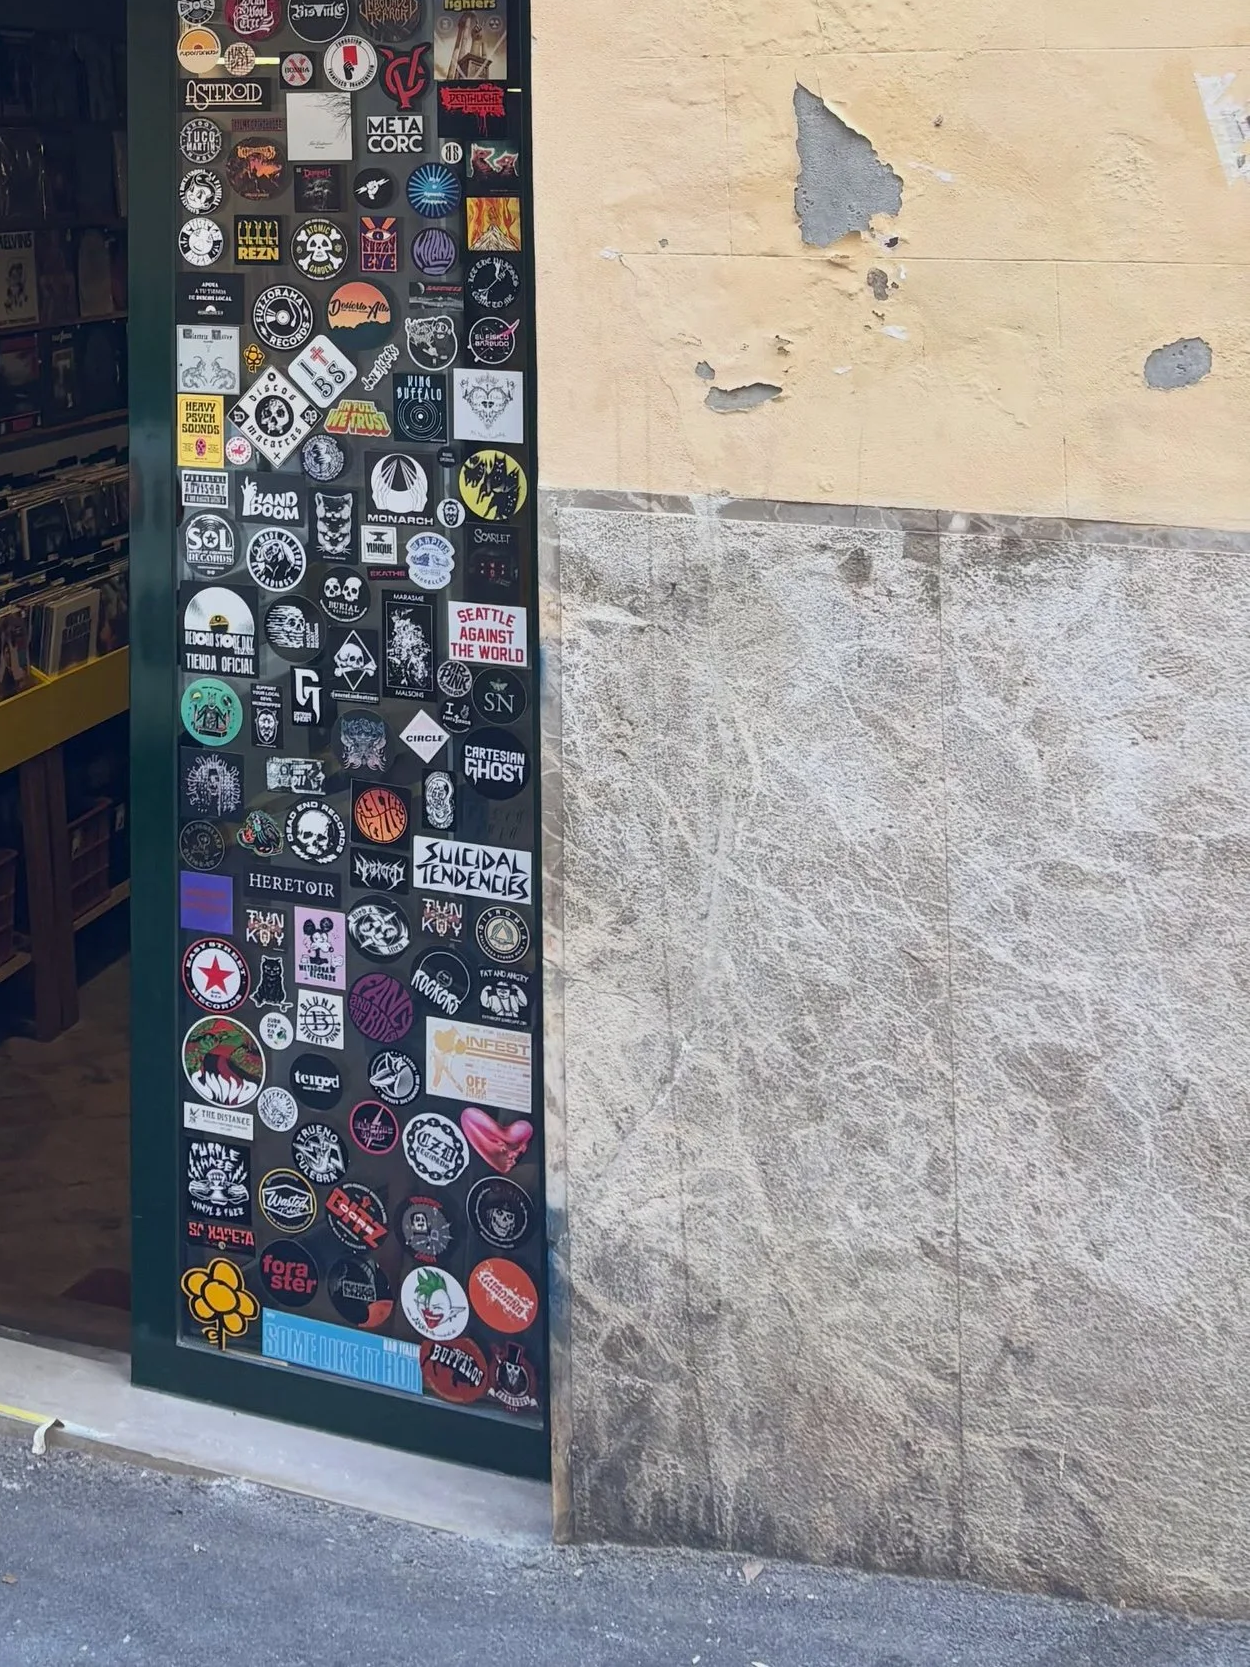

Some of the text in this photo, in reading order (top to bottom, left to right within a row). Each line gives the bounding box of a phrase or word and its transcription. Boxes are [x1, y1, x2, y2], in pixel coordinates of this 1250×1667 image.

[185, 80, 262, 111] ASTEROID
[367, 117, 423, 134] META
[186, 131, 216, 142] TUCO
[367, 135, 423, 153] CORC
[306, 223, 331, 235] ATOMIC
[238, 248, 279, 260] REZN
[363, 238, 396, 253] FUZZY
[308, 263, 334, 275] GARDEN
[363, 253, 396, 271] EYE
[255, 288, 304, 324] FUZZORAMA
[269, 321, 310, 347] RECORDS
[407, 375, 431, 386] KING
[396, 387, 442, 402] BUFFALO
[185, 401, 216, 413] HEAVY
[185, 413, 216, 423] PSYCH
[350, 411, 390, 432] TRUST
[181, 424, 220, 435] SOUNDS
[253, 491, 299, 507] HAND
[251, 503, 300, 520] DOOM
[367, 513, 434, 526] MONARCH
[187, 526, 233, 551] SOL
[457, 606, 517, 628] SEATTLE
[459, 626, 514, 645] AGAINST
[451, 642, 524, 663] THE WORLD
[186, 653, 255, 675] TIENDA OFICIAL
[483, 692, 515, 714] SN
[464, 745, 525, 765] CARTESIAN
[464, 758, 524, 785] GHOST
[286, 801, 346, 854] DEAD END RECORDS
[421, 841, 529, 875] SUICIDAL
[249, 873, 336, 897] HERETOIR
[415, 863, 530, 900] TENDENCIES
[185, 942, 247, 976] EASY STREET
[480, 969, 493, 978] FAT
[191, 988, 243, 1010] RECORDS
[301, 996, 336, 1011] BLUNT
[300, 1026, 322, 1044] STREET
[466, 1035, 530, 1056] INFEST
[466, 1075, 487, 1087] OFF
[202, 1109, 251, 1127] THE DISTANCE
[296, 1124, 339, 1143] TRUENO
[191, 1142, 241, 1162] PURPLE
[198, 1156, 235, 1172] HAZE
[295, 1152, 338, 1183] CULEBRA
[265, 1191, 310, 1209] Wasted
[262, 1254, 308, 1279] fora
[270, 1274, 317, 1294] ster
[264, 1321, 317, 1365] SOME
[319, 1335, 359, 1379] LIKE
[362, 1344, 381, 1381] IT
